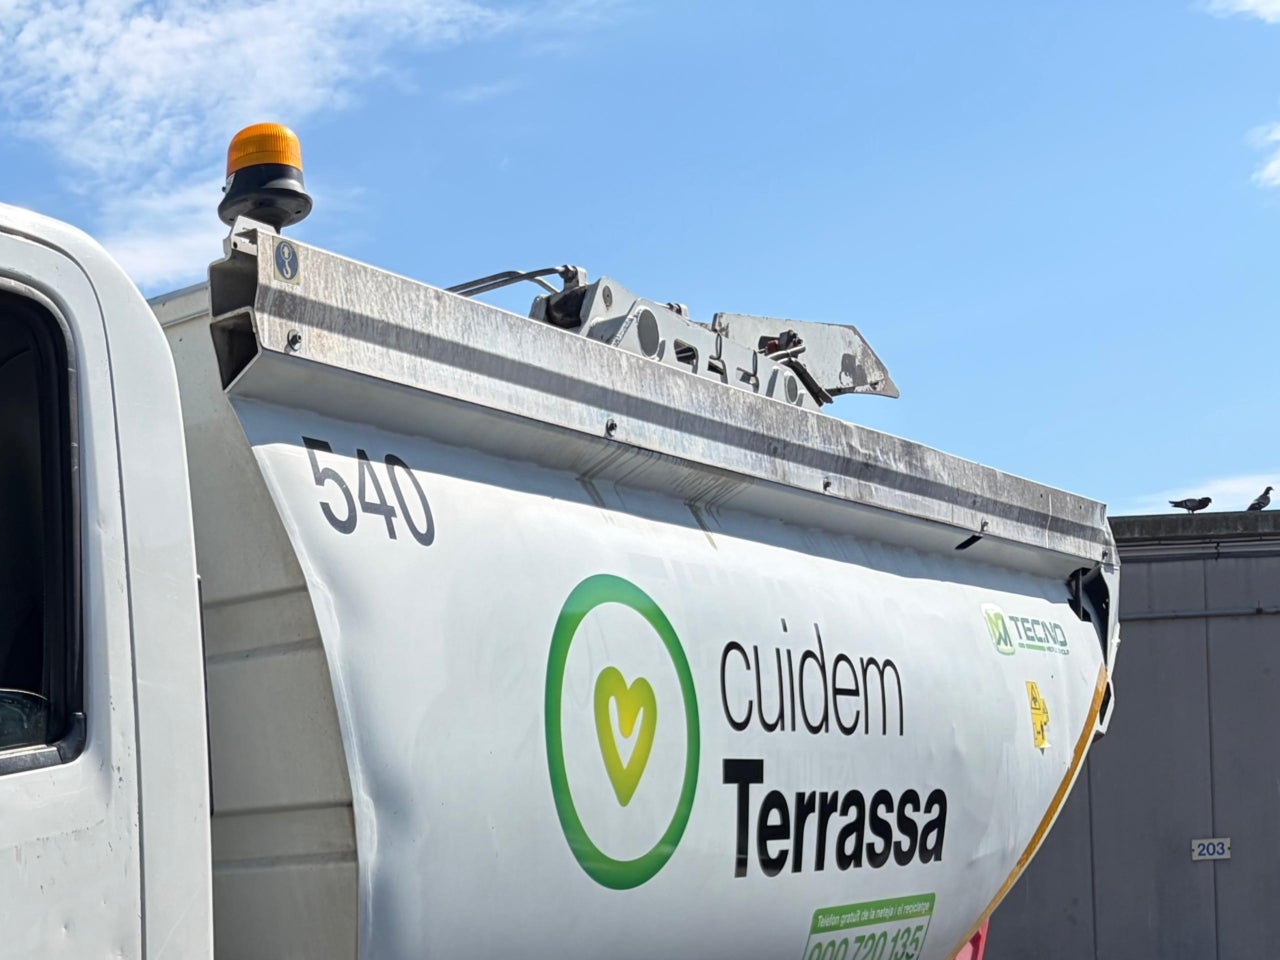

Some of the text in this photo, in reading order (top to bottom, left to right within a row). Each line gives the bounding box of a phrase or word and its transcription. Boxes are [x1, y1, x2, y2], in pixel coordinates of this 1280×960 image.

[301, 435, 435, 547] 540
[719, 617, 904, 737] cuidem
[721, 757, 948, 879] Terrassa
[1197, 841, 1226, 857] 203
